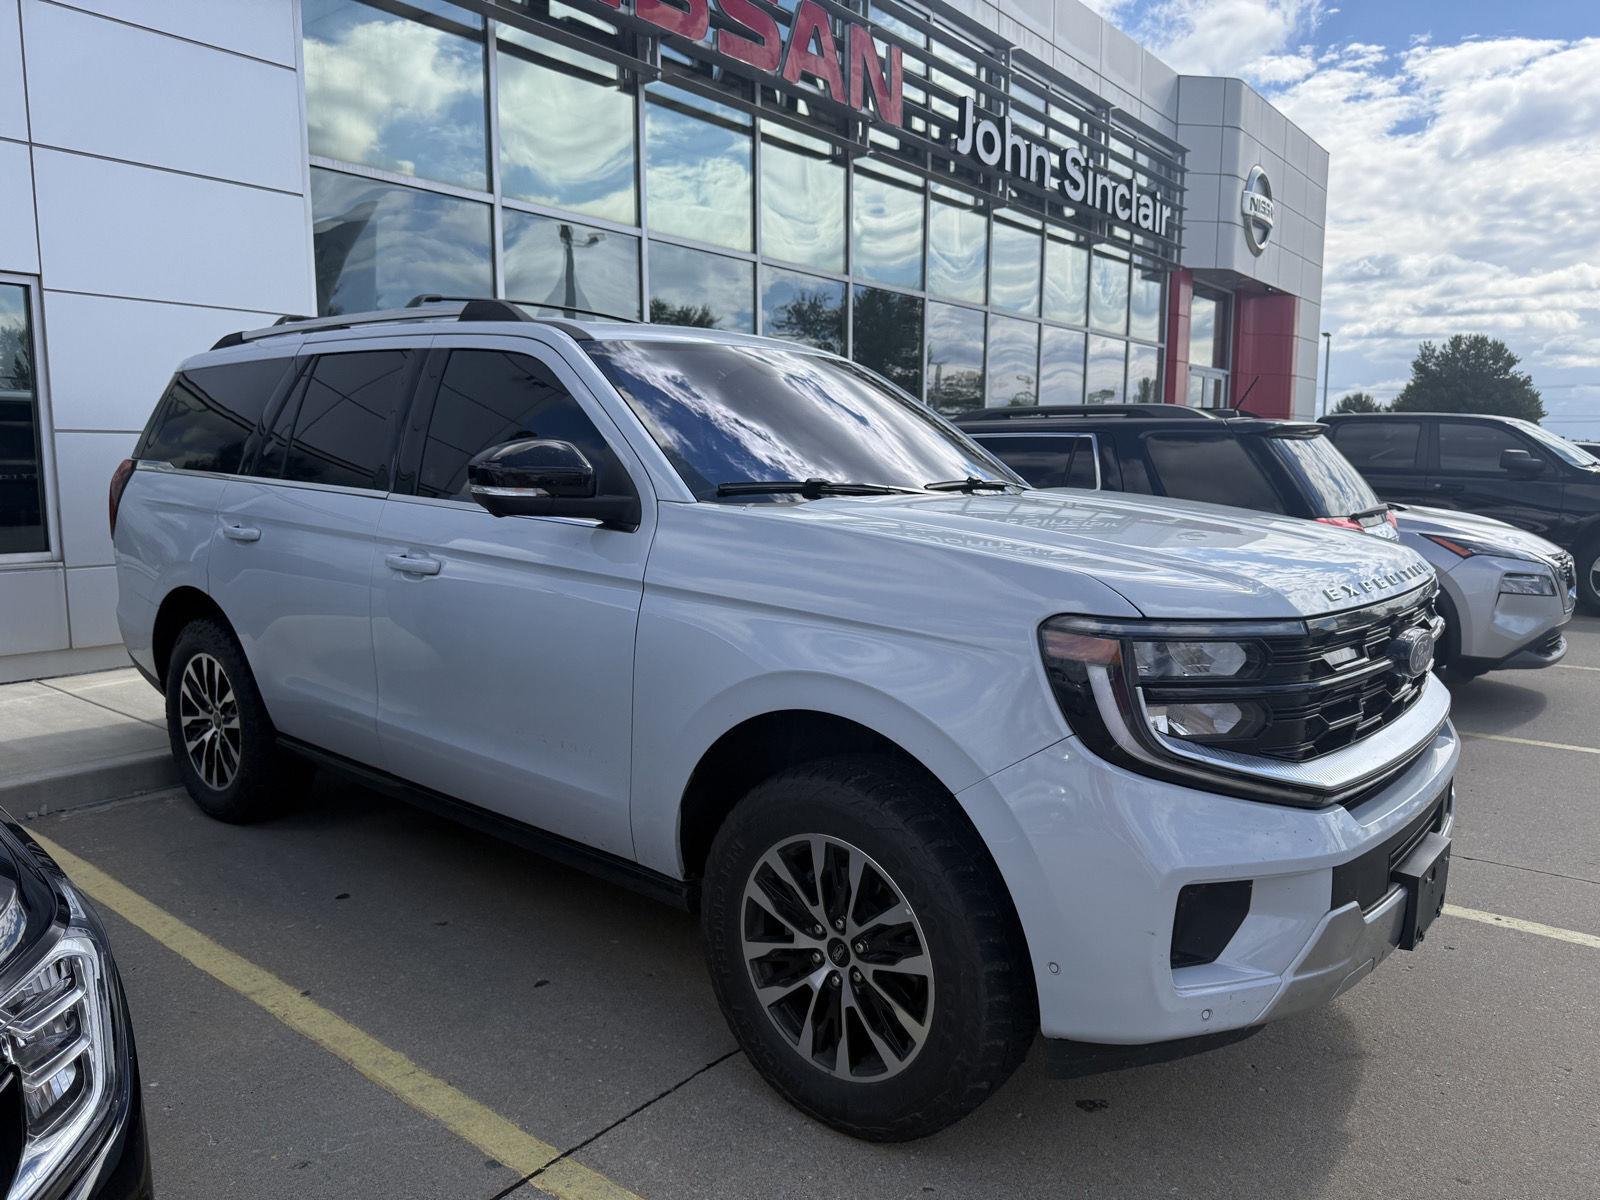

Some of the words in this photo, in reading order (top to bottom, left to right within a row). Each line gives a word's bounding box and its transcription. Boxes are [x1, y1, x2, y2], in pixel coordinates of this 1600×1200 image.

[956, 96, 1051, 188] John
[1063, 147, 1171, 236] Sinclair
[1249, 196, 1273, 221] NISS
